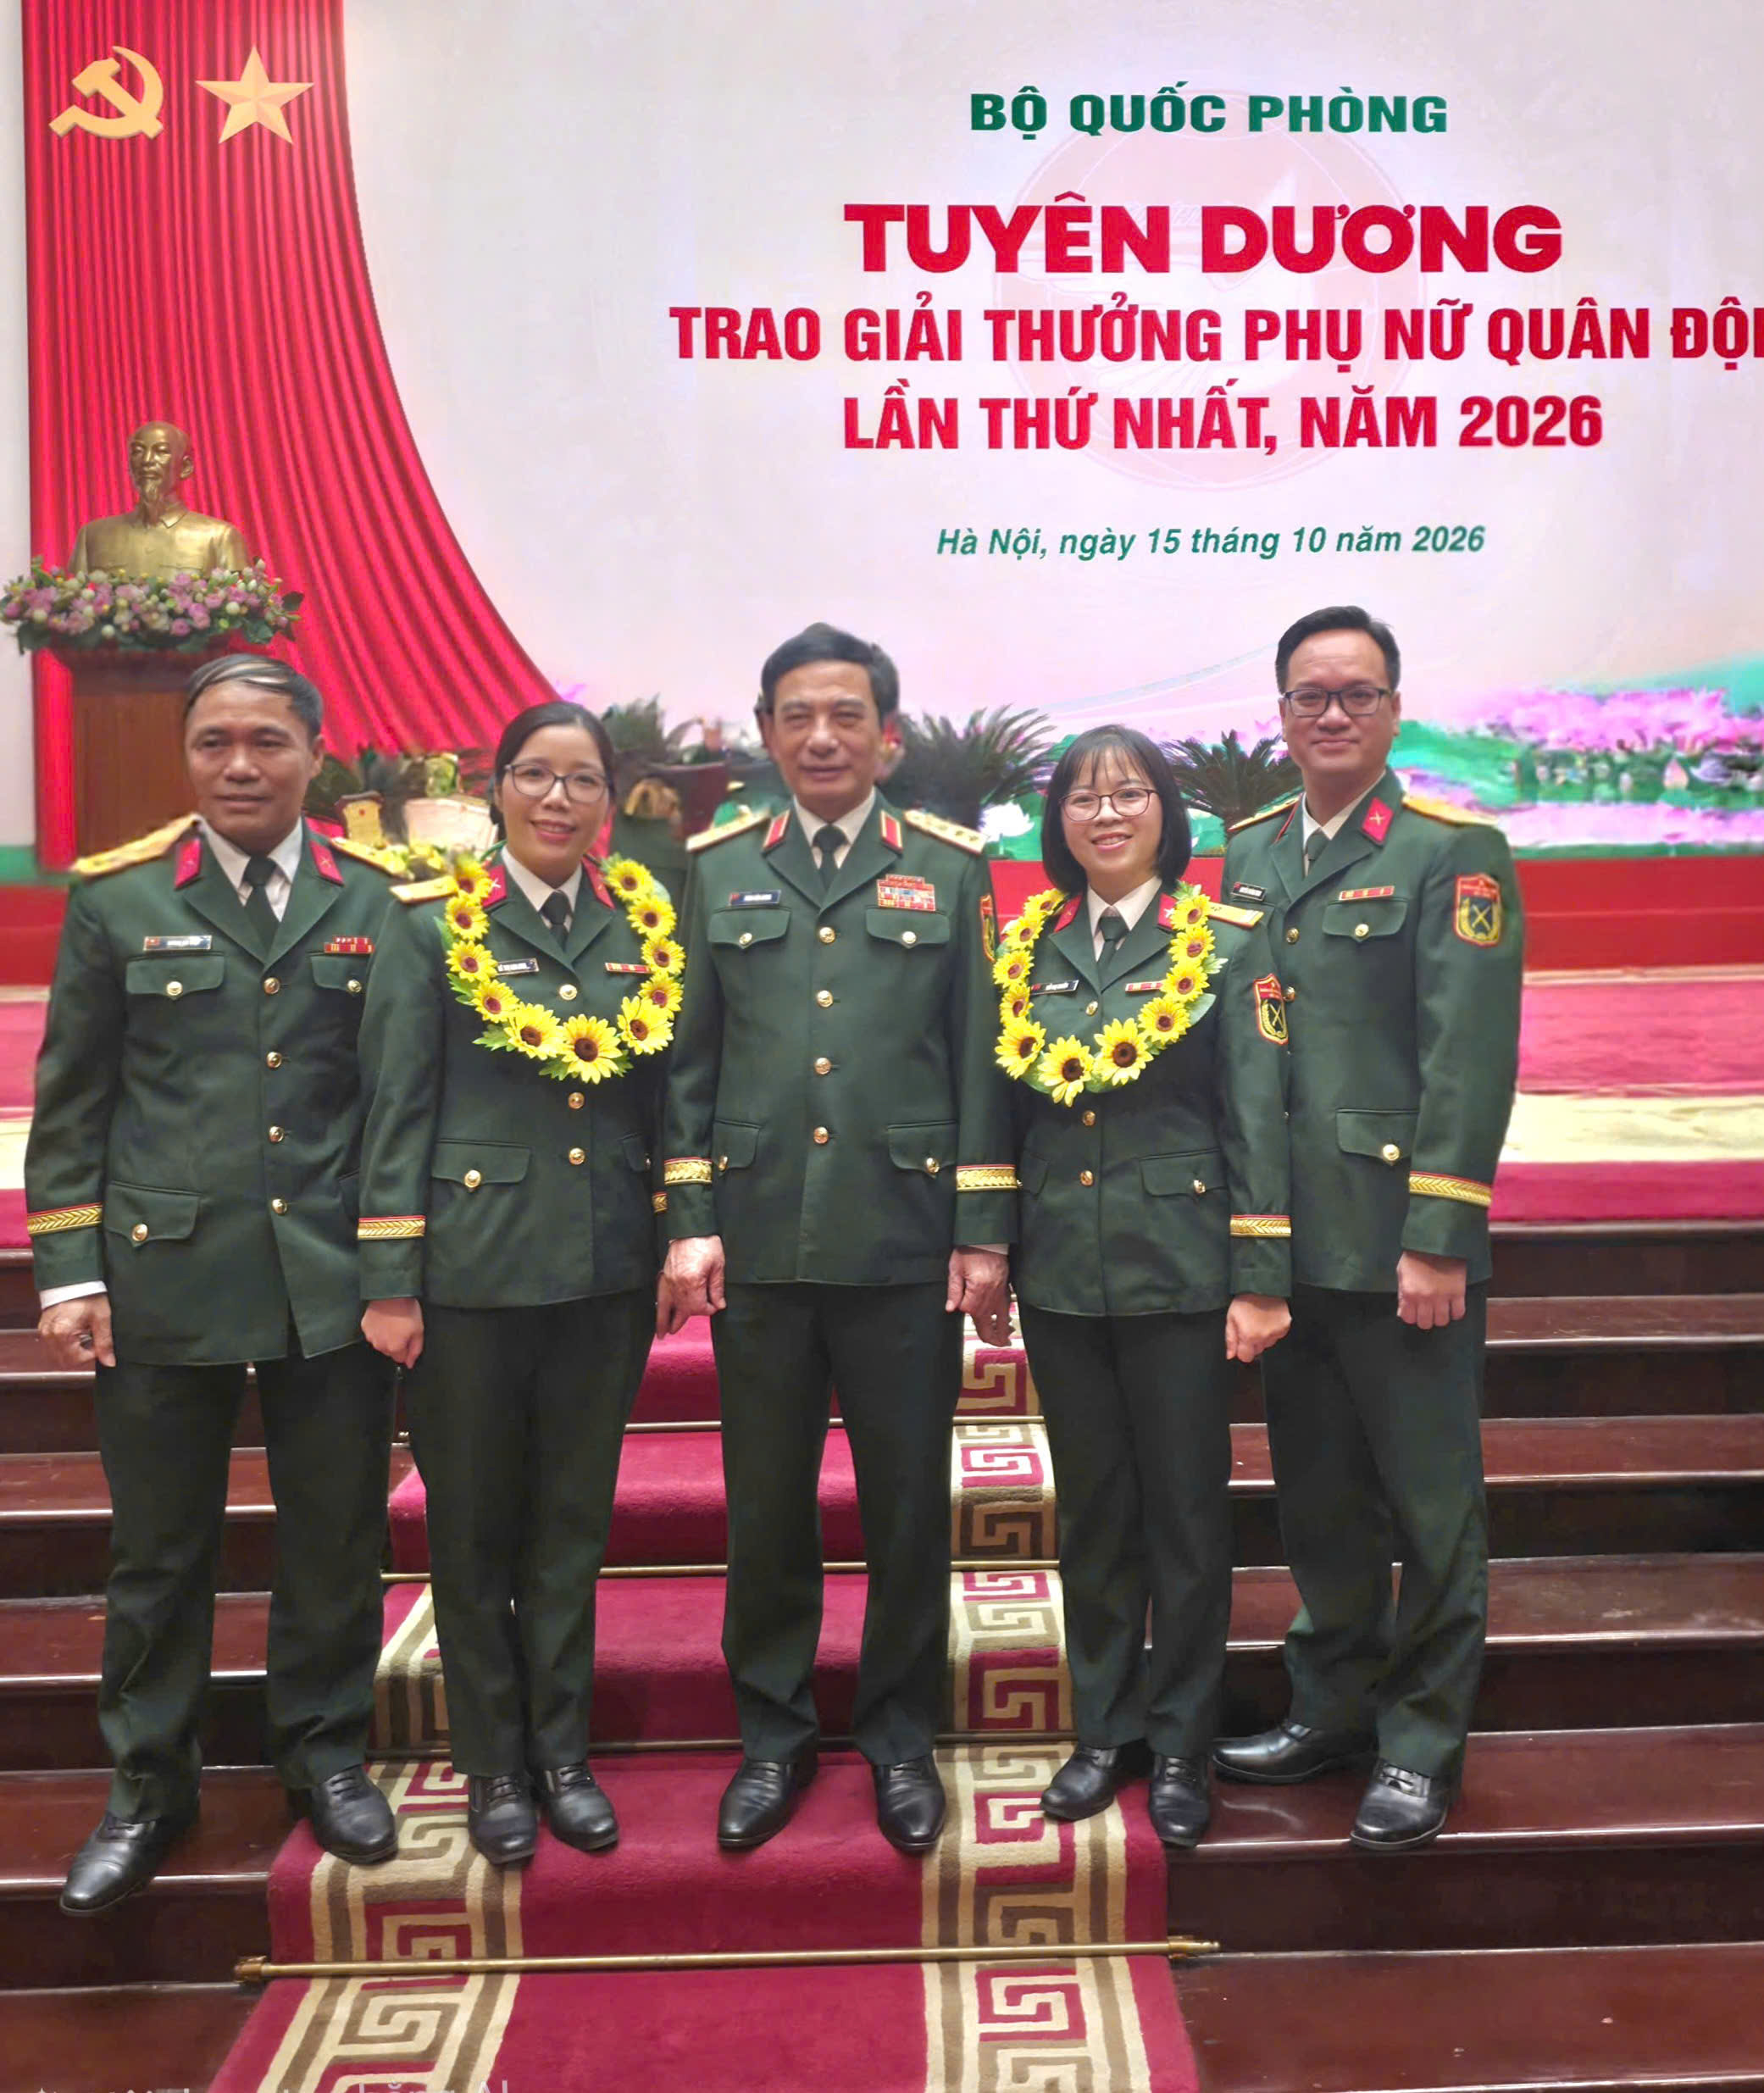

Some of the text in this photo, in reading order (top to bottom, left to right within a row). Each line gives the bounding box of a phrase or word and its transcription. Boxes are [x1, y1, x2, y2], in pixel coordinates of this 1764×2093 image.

[971, 80, 1447, 141] BỘ QUỐC PHÒNG
[844, 191, 1562, 273] TUYÊN DƯƠNG
[668, 291, 1764, 373] TRAO GIẢI THƯỞNG PHỤ NỮ QUÂN ĐỘI
[844, 378, 1603, 455] LẦN THỨ NHẤT, NĂM 2026
[937, 525, 1484, 561] Hà Nội, ngày 15 tháng 10 năm 2026
